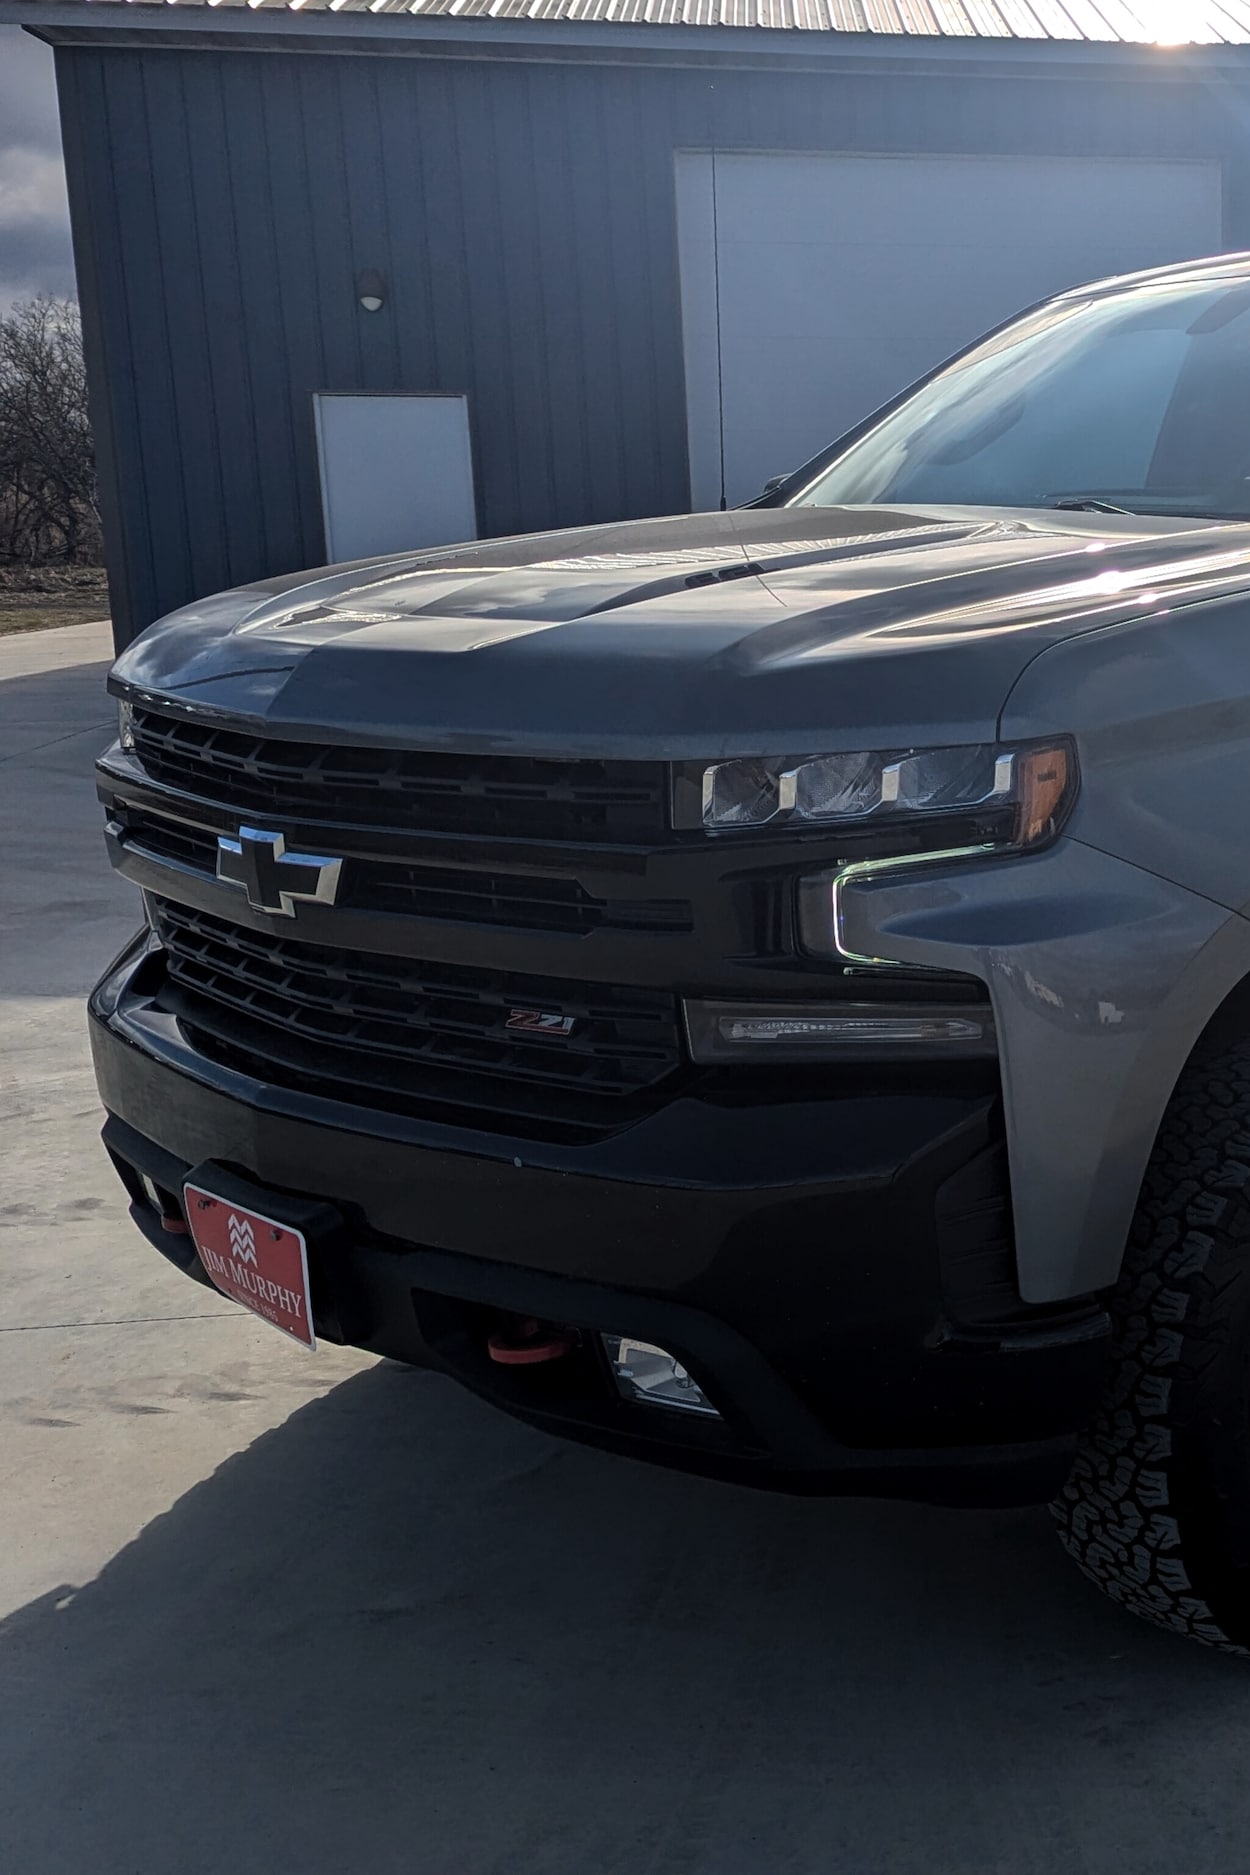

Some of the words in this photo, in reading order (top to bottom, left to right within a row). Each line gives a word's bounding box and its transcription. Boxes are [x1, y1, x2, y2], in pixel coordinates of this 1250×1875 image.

[505, 1008, 576, 1036] Z71
[201, 1246, 229, 1278] JIM
[228, 1257, 302, 1318] MURPHY
